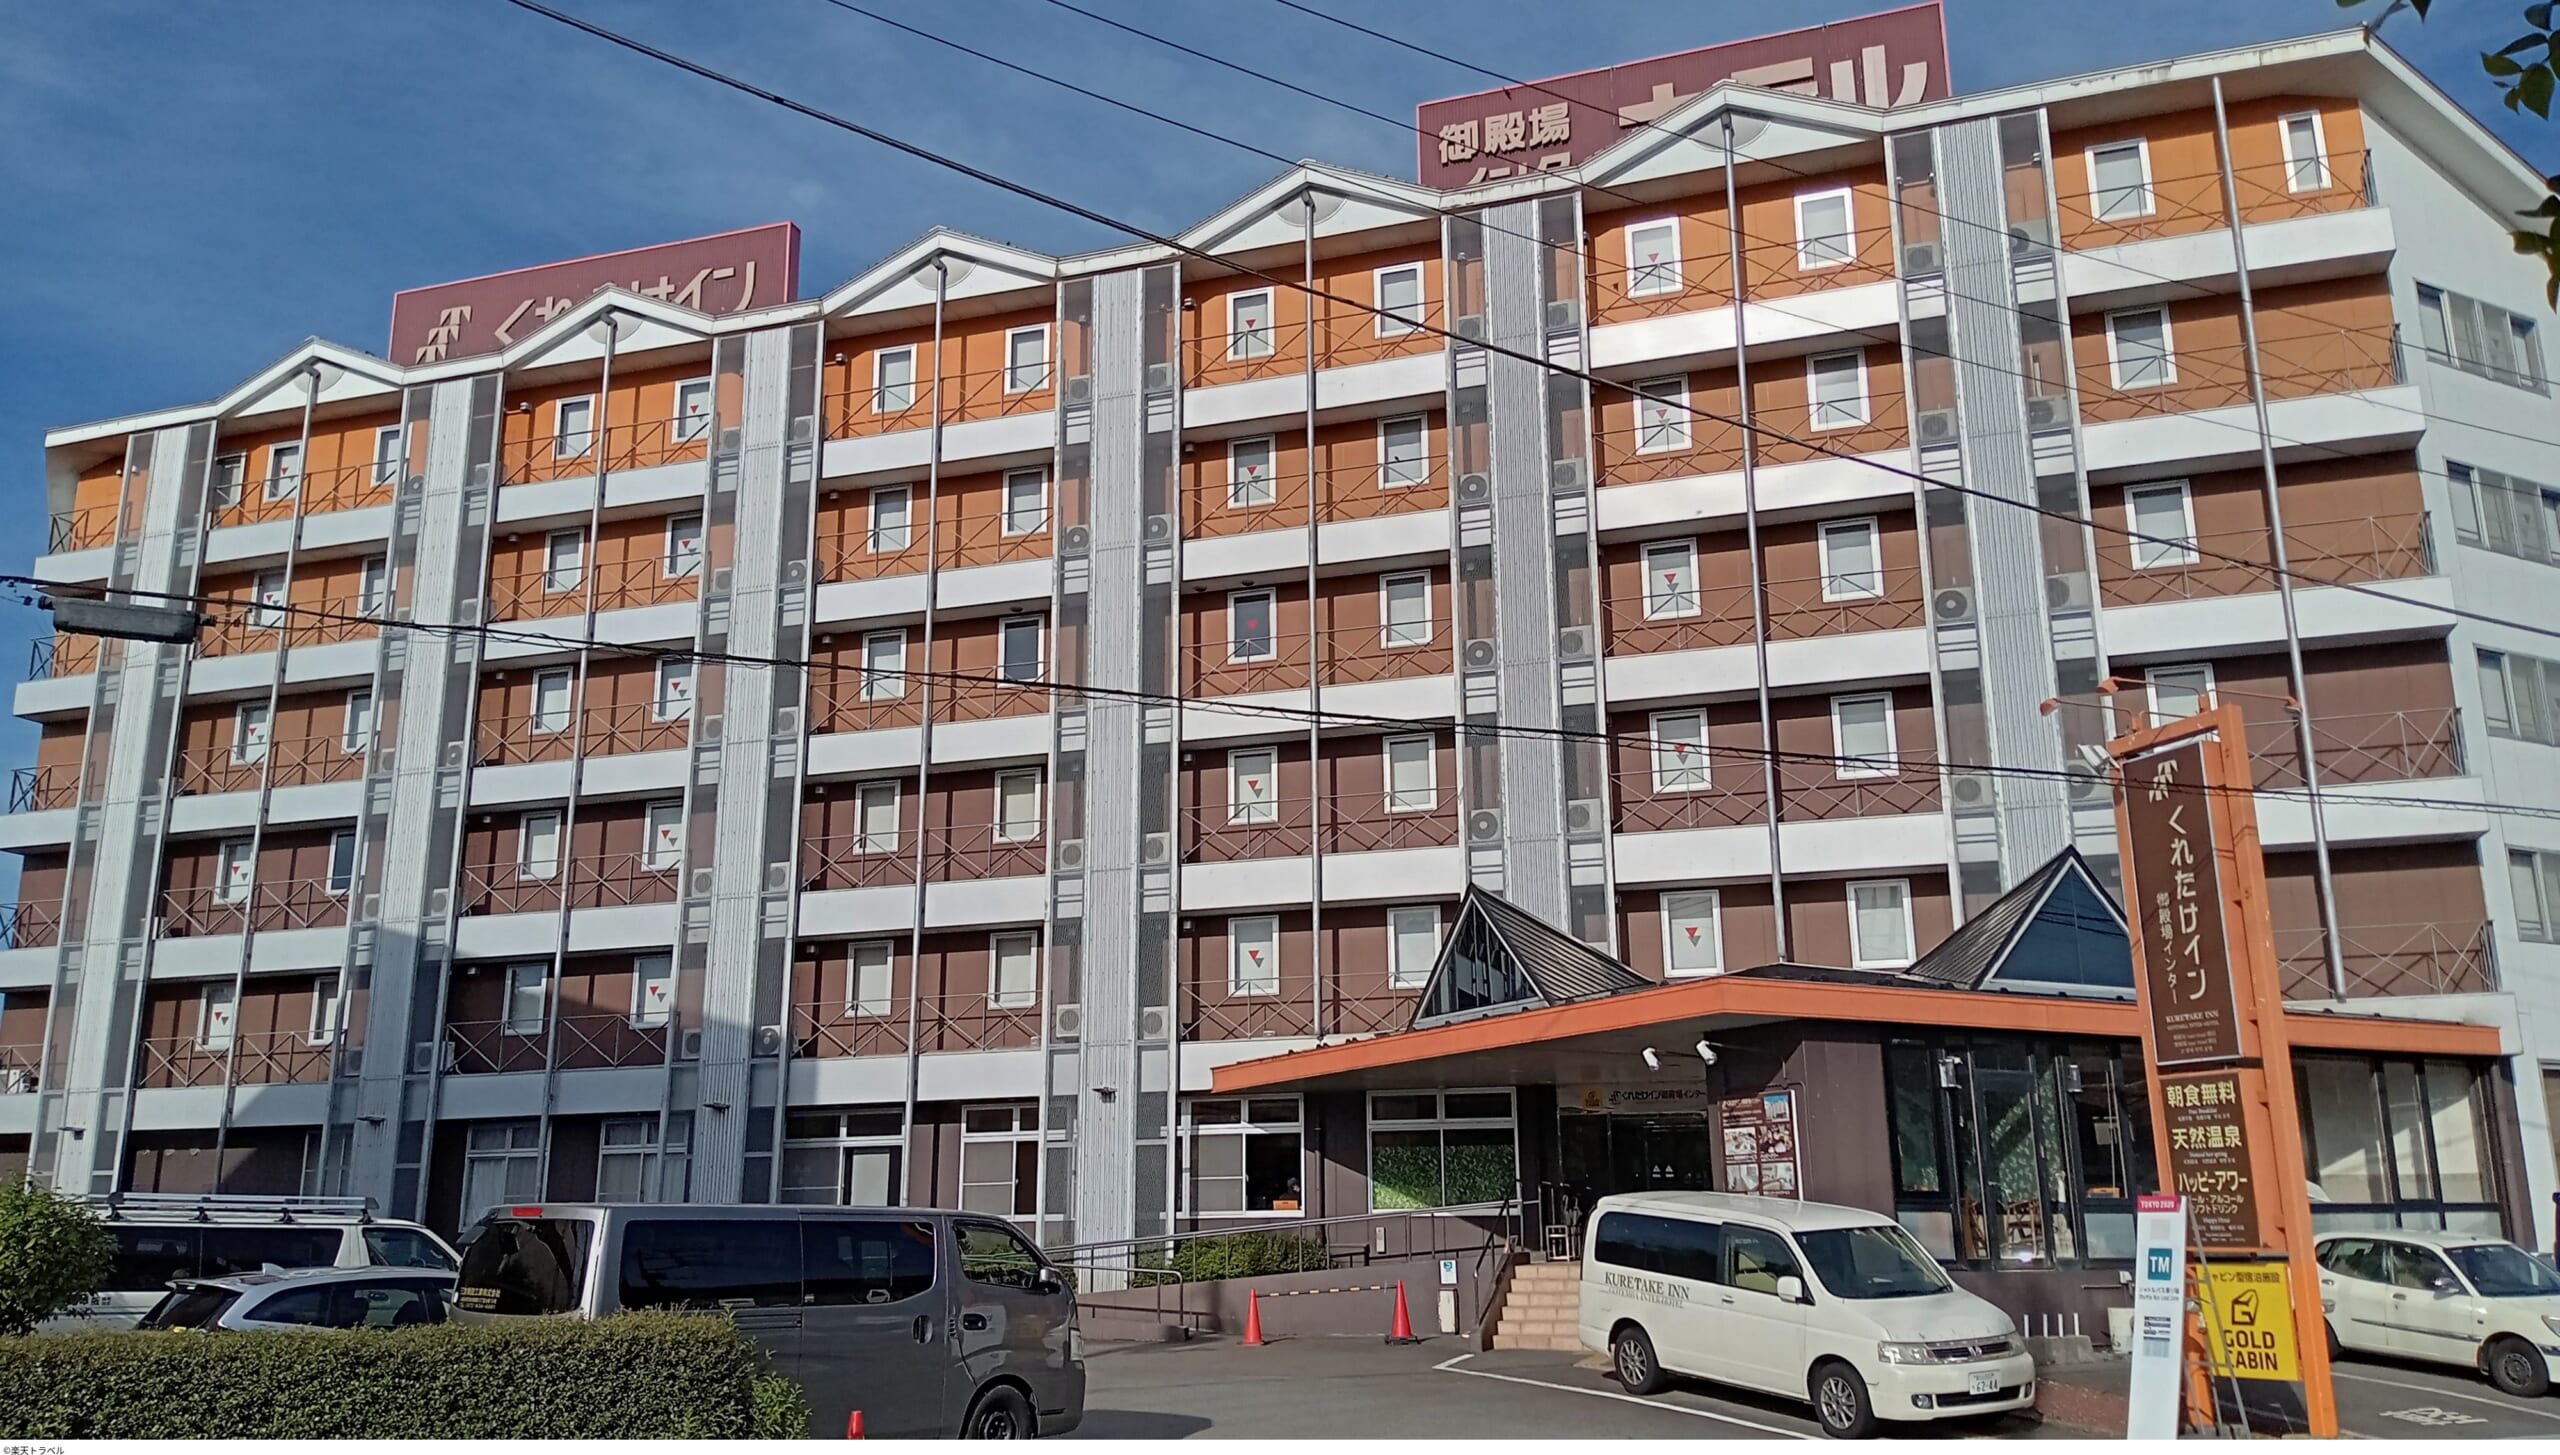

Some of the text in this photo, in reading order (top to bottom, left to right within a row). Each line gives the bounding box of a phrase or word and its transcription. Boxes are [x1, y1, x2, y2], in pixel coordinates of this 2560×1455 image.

[1438, 101, 1571, 165] 御殿場
[2168, 805, 2207, 1001] くれたけイン
[2157, 892, 2178, 1004] 御殿場インター
[2204, 1009, 2219, 1019] INN
[2166, 1080, 2236, 1108] 朝食無料
[2172, 1125, 2242, 1150] 天然温泉
[2178, 1171, 2248, 1193] ハッピーアワー
[2141, 1201, 2175, 1209] TOKYO 2020
[2190, 1195, 2244, 1204] ール・アルコール
[2149, 1256, 2170, 1273] TM
[1605, 1271, 1690, 1300] KURETAKE INN
[2212, 1272, 2280, 1283] ャビン型宿泊施設
[2224, 1329, 2275, 1350] GOLD
